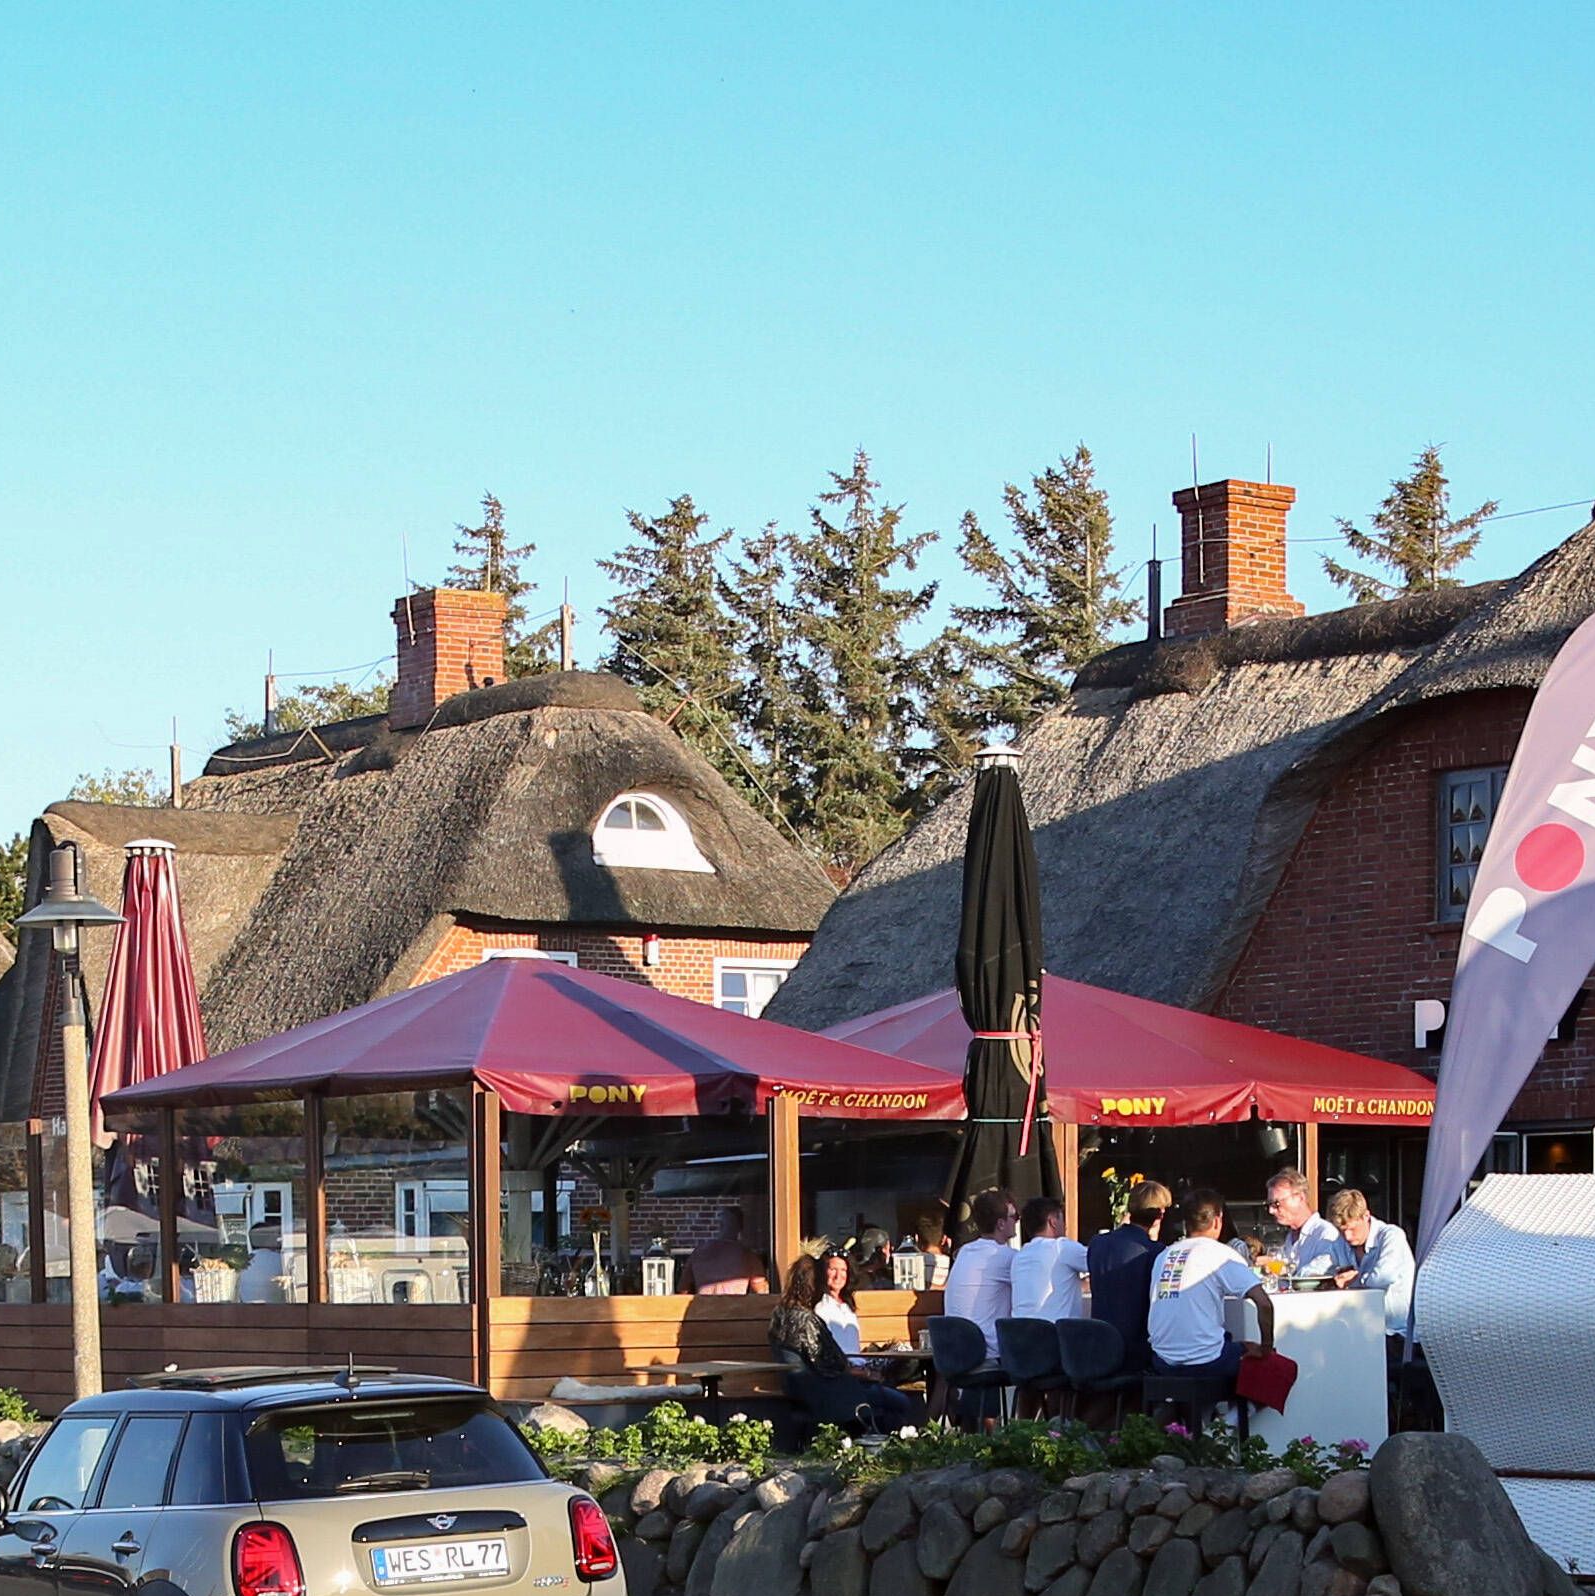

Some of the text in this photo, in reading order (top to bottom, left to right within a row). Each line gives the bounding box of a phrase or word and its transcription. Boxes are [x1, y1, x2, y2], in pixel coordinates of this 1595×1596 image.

[568, 1084, 648, 1104] PONY
[843, 1092, 928, 1109] CHANDON
[1100, 1096, 1167, 1116] PONY
[1367, 1099, 1435, 1116] CHANDON
[388, 1543, 503, 1573] WES RL 77
